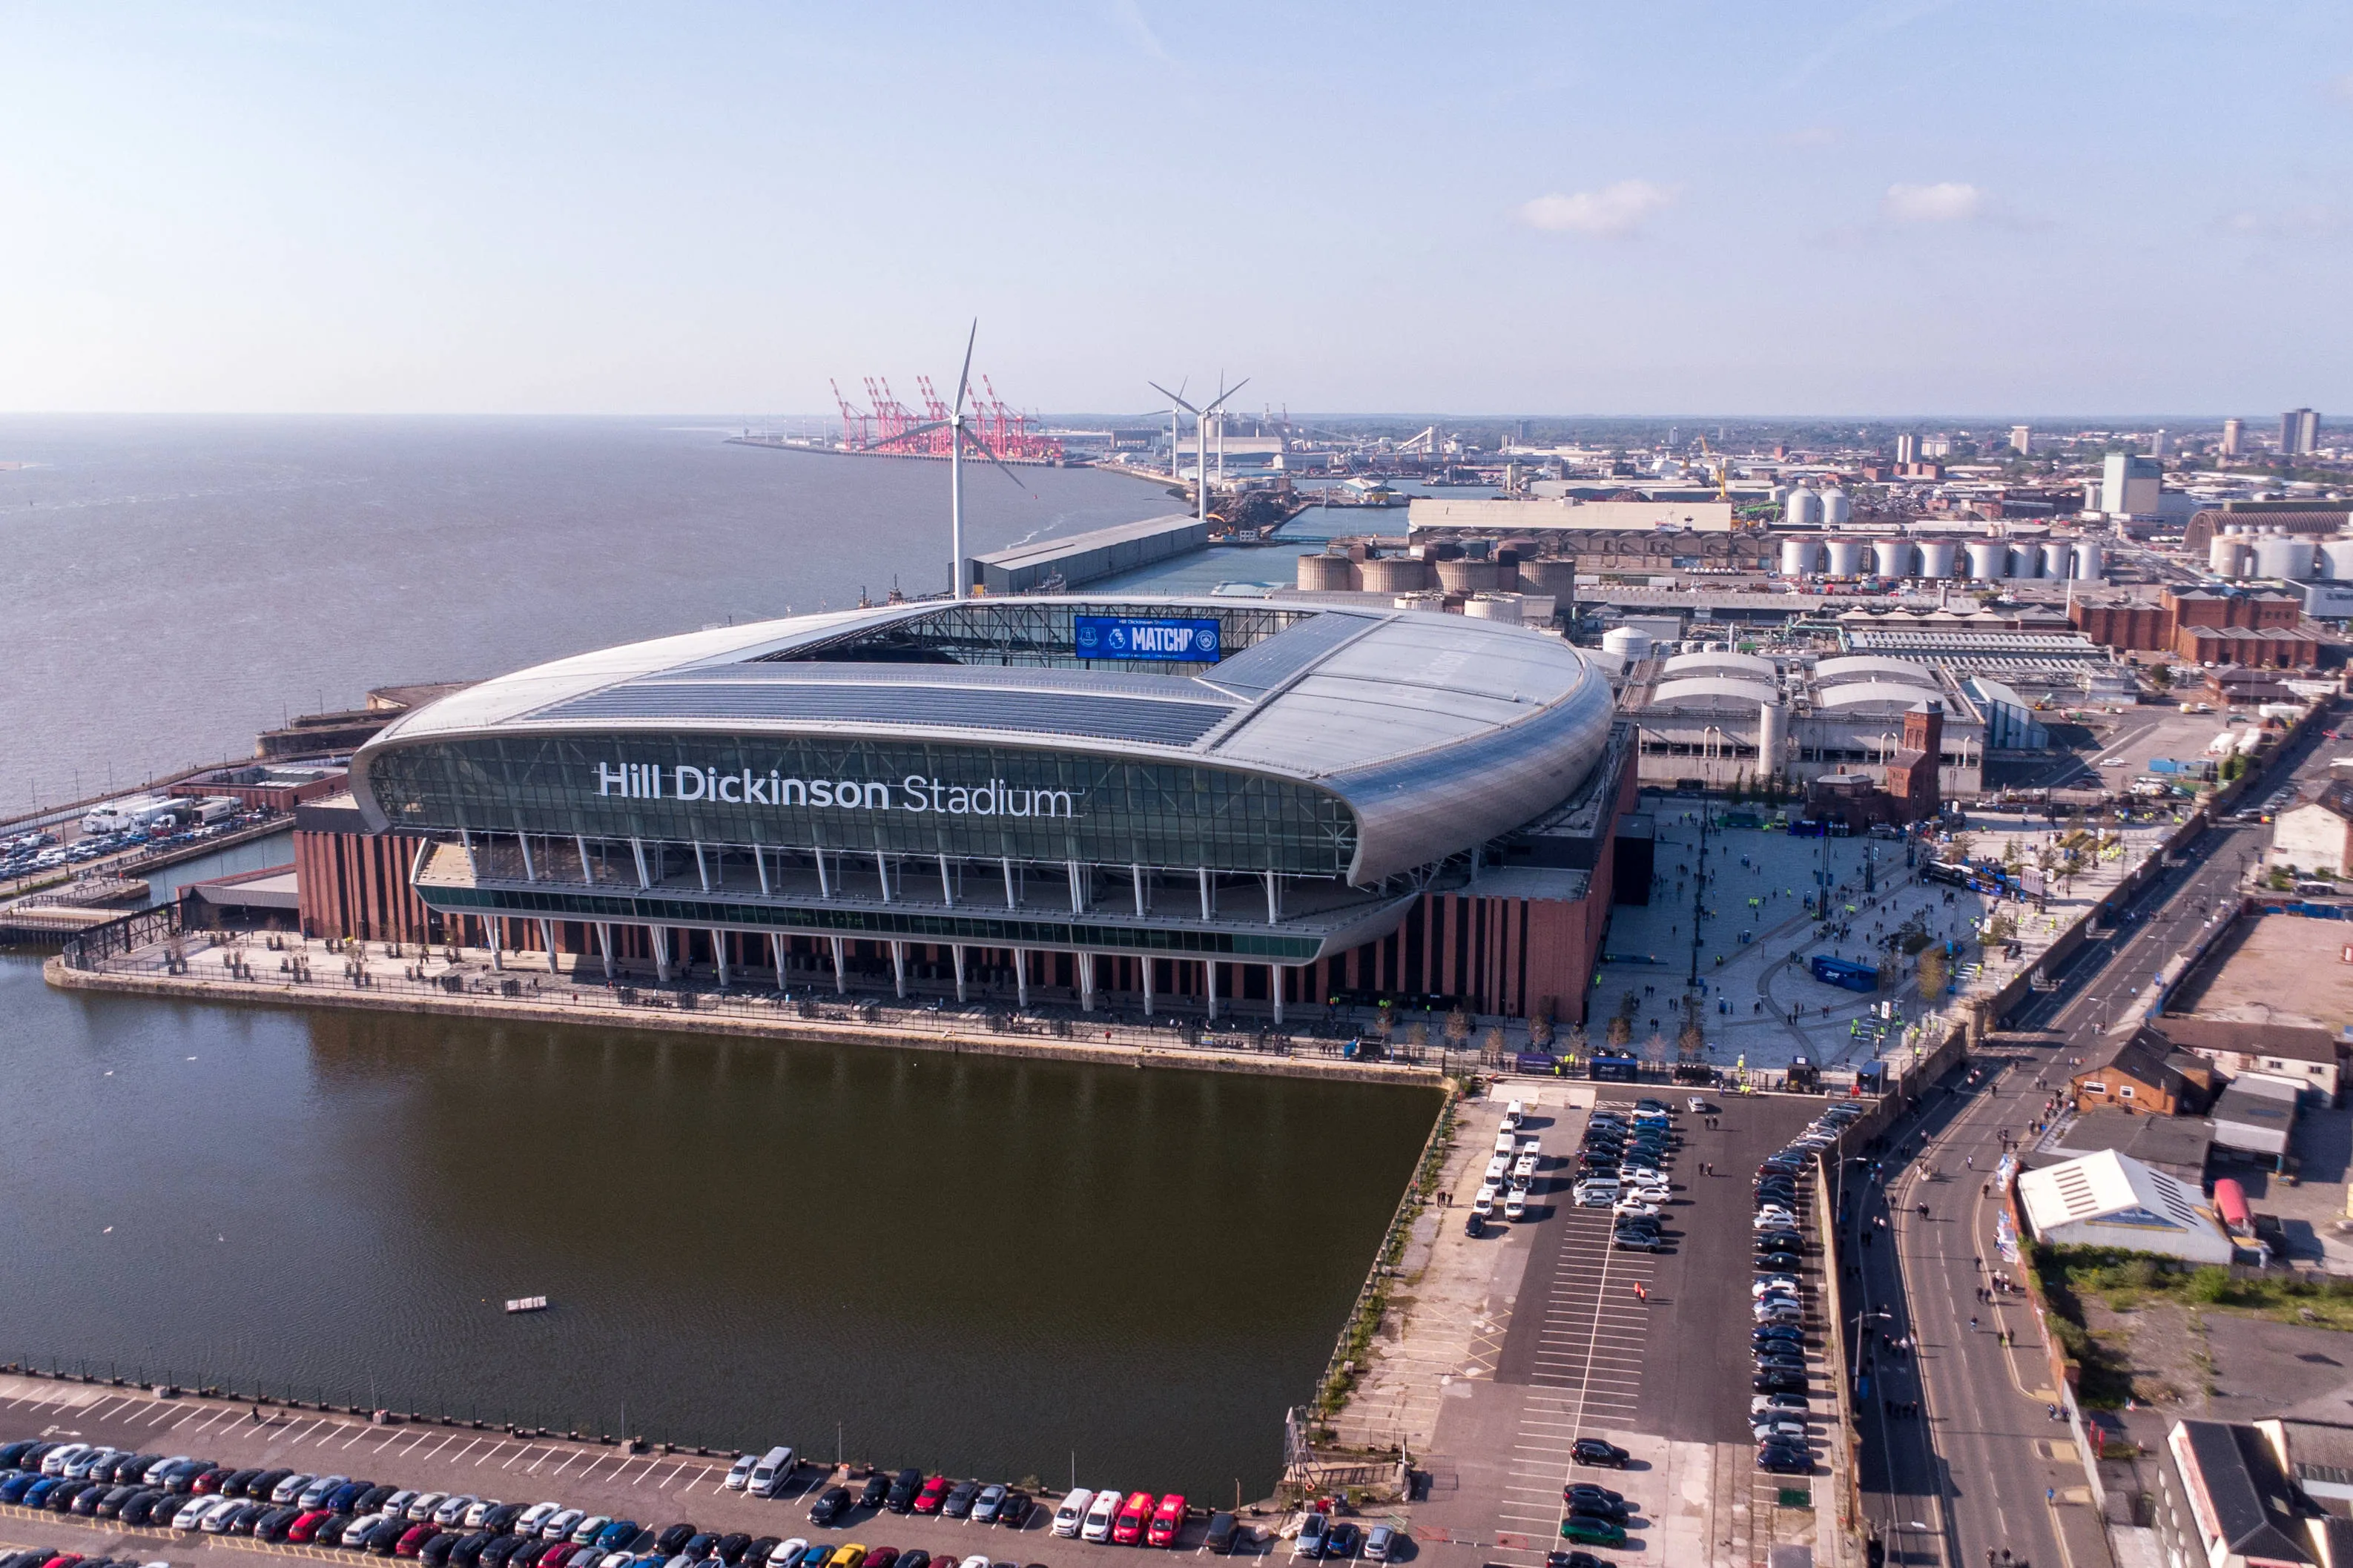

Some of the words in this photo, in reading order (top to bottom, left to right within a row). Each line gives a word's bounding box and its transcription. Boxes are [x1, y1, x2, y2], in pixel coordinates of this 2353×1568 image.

[599, 762, 660, 798] Hill
[676, 765, 890, 809] Dickinson
[903, 775, 1072, 818] Stadium
